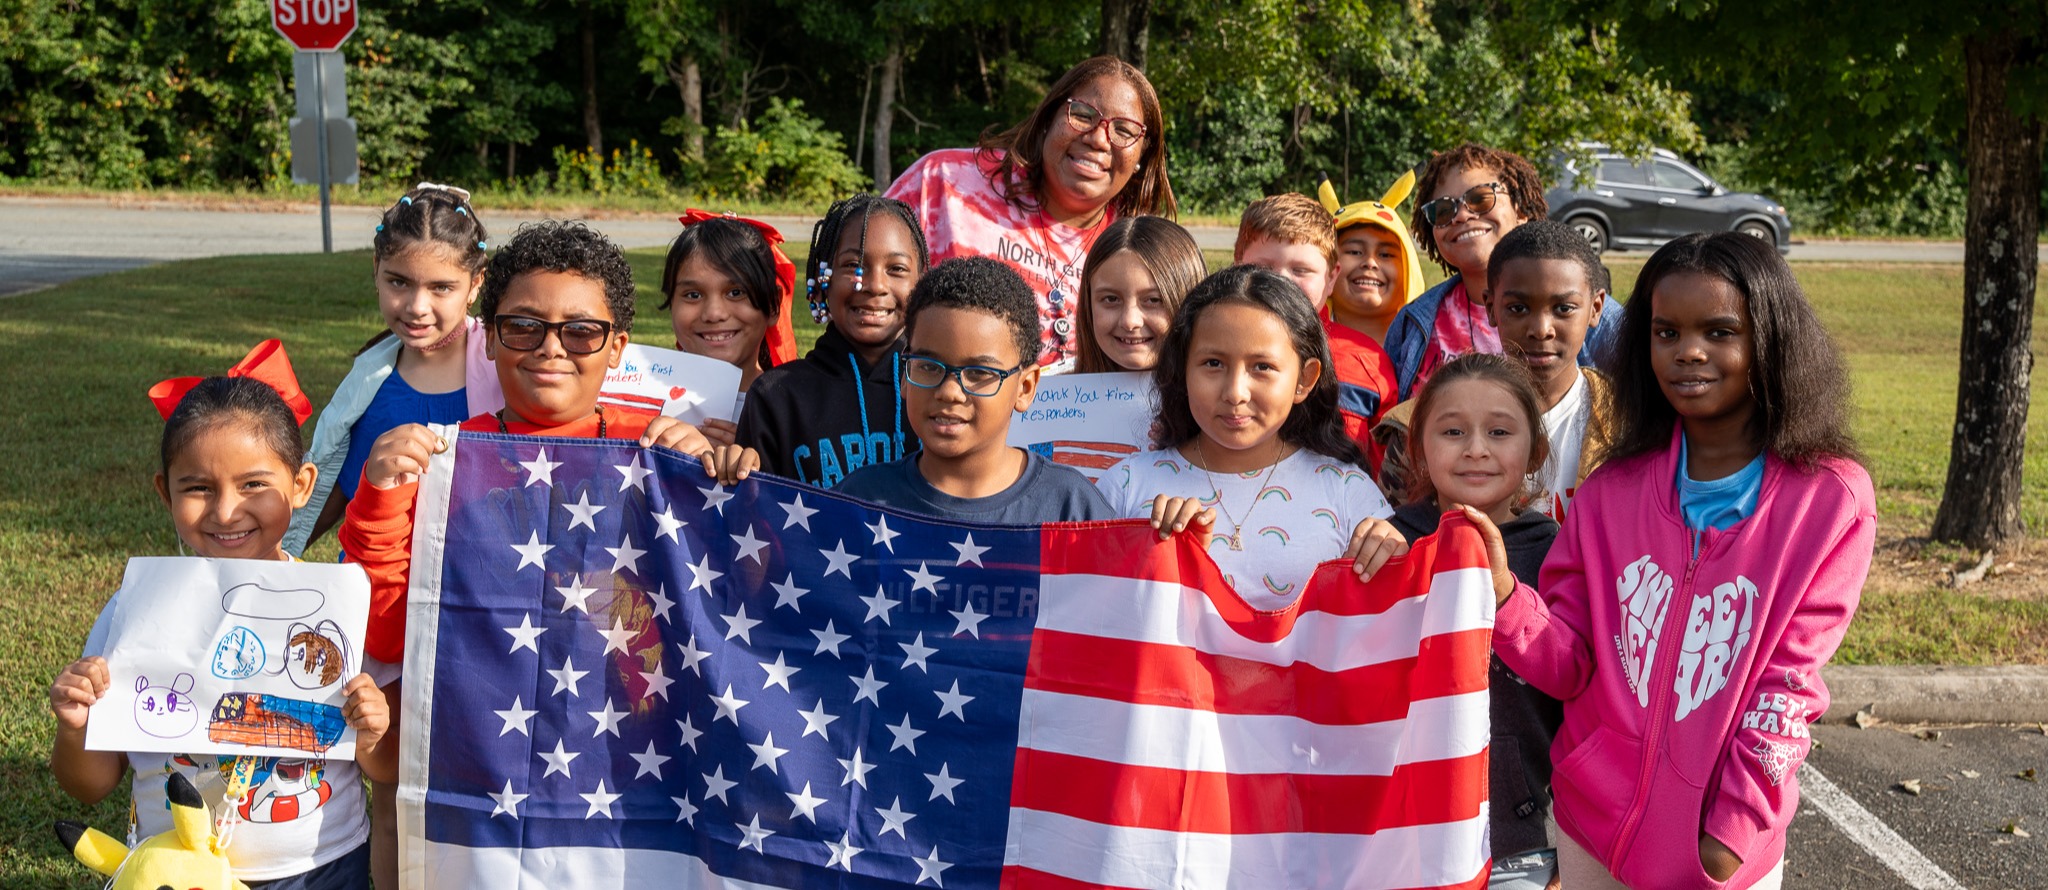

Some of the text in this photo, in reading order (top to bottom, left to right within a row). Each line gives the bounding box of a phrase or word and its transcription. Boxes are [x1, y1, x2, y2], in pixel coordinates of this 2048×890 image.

[278, 0, 352, 25] STOP
[997, 237, 1057, 271] NORTH
[1020, 268, 1081, 295] ELEMEN
[625, 360, 638, 375] You
[1033, 387, 1069, 404] hank
[1074, 385, 1100, 404] You
